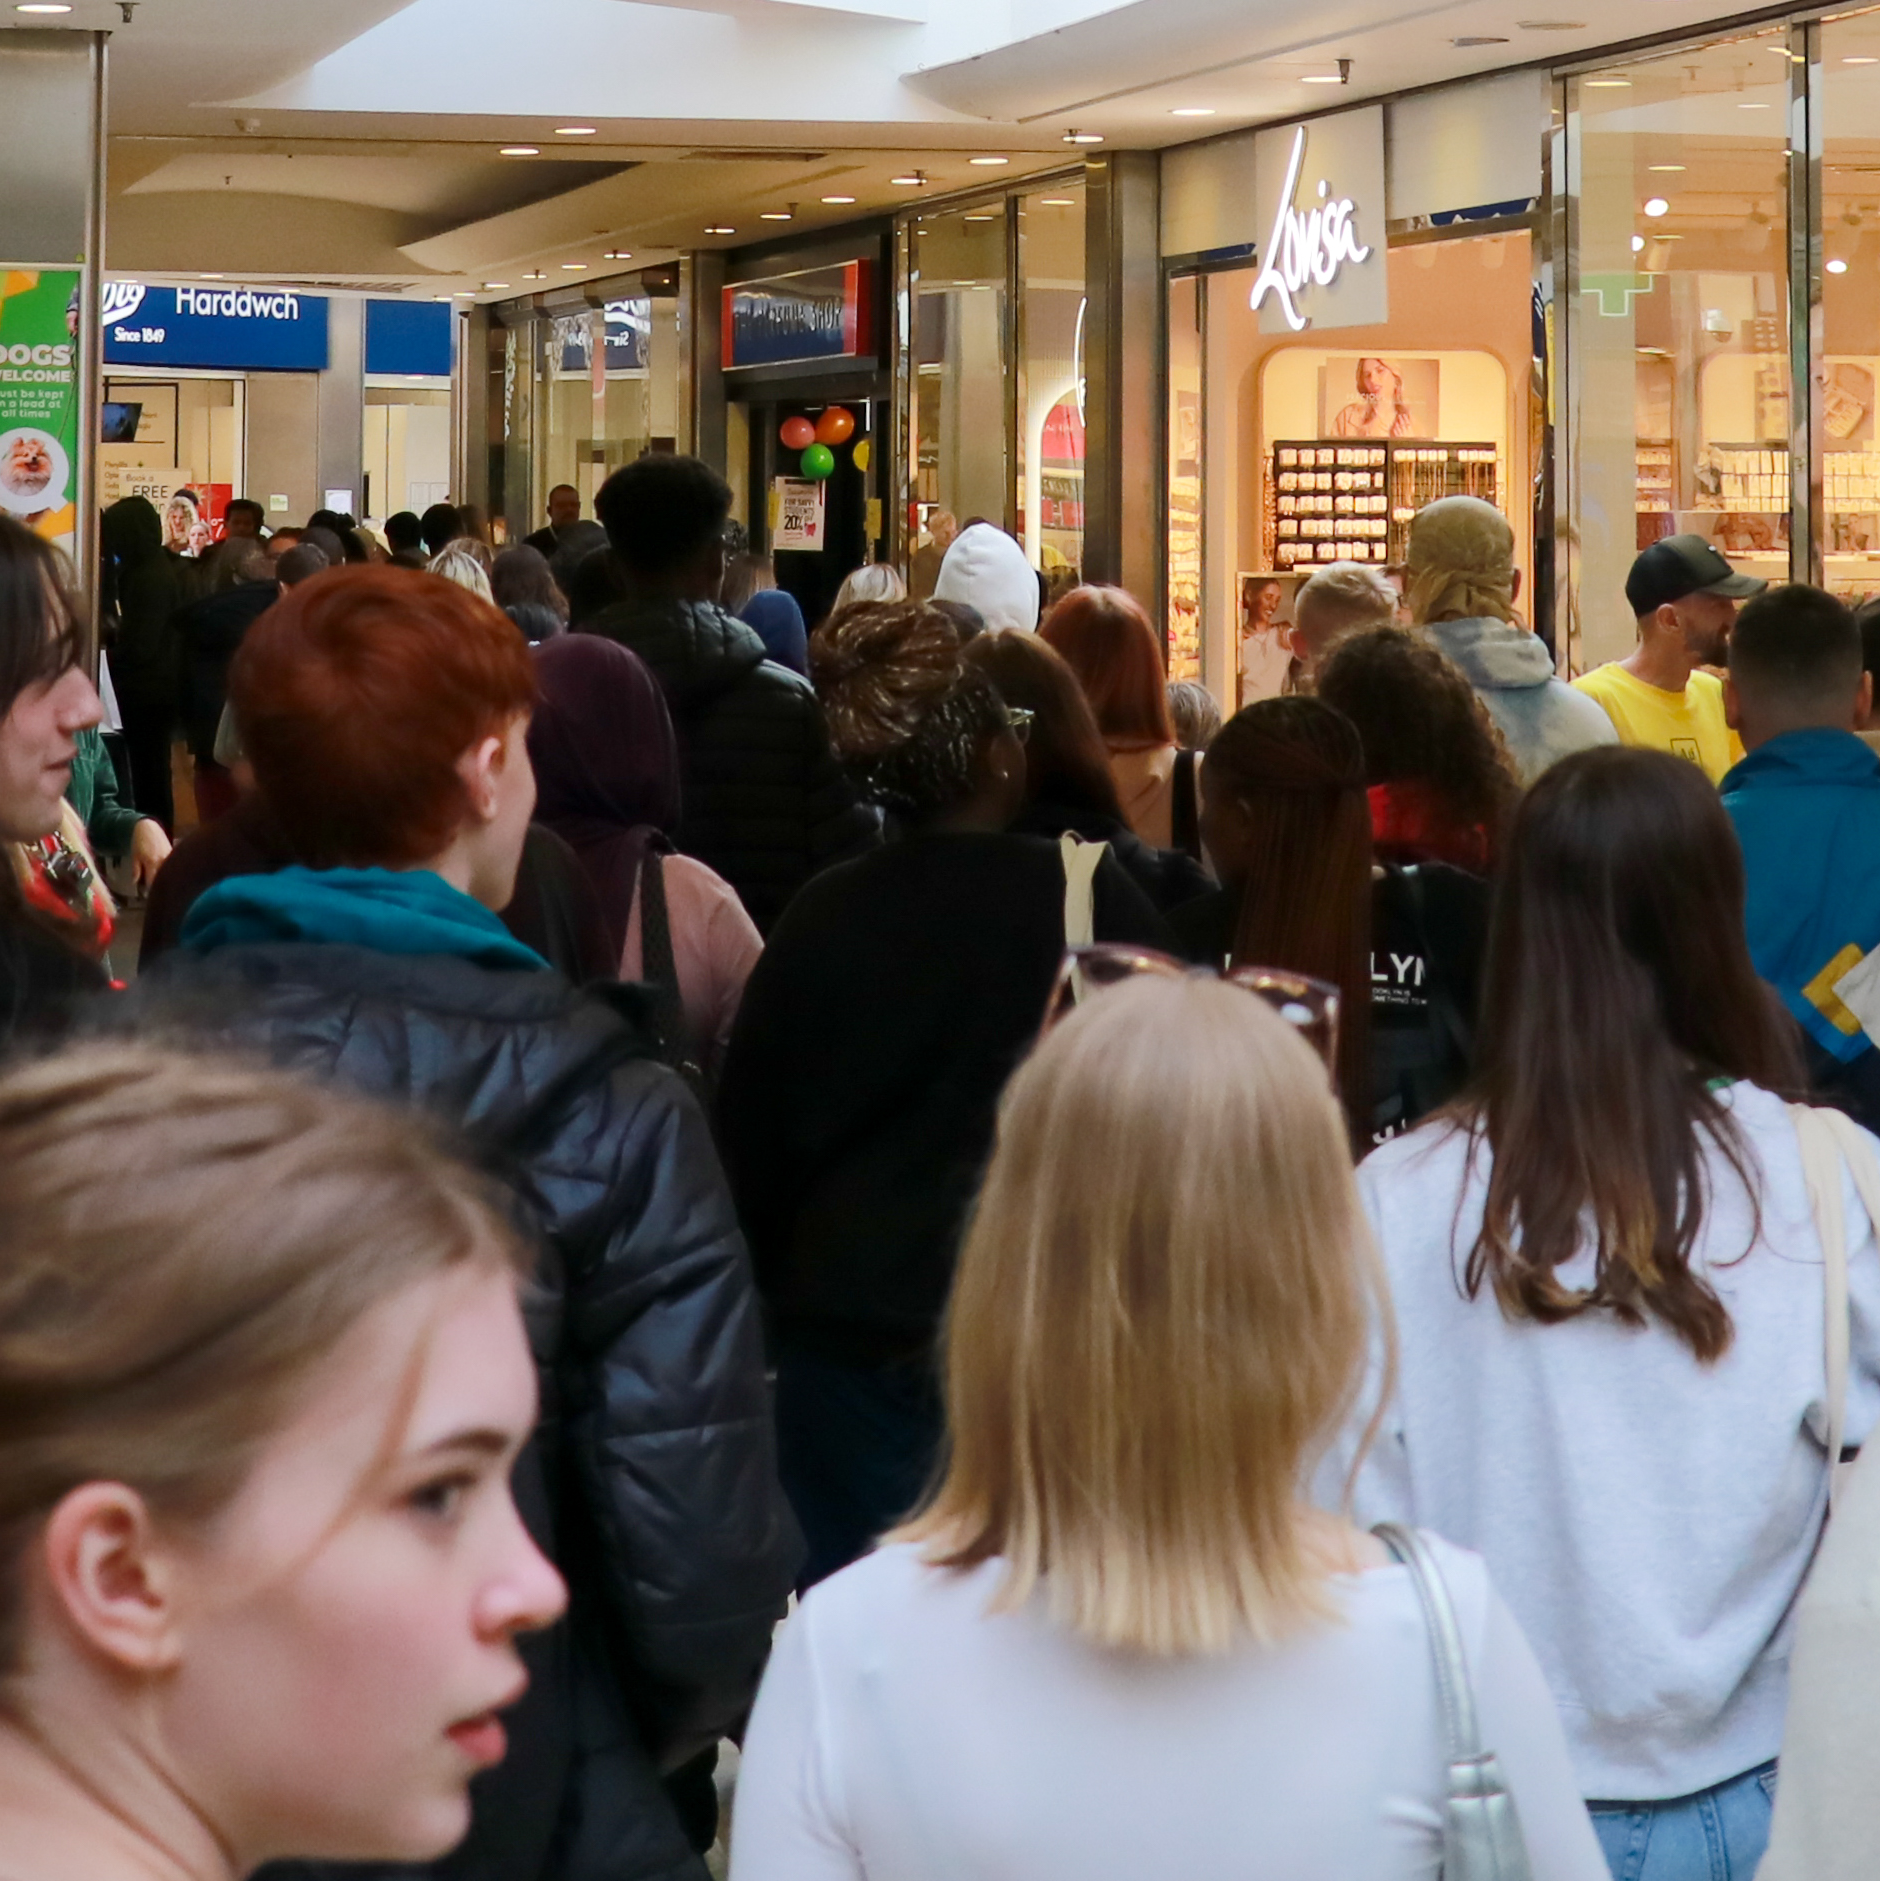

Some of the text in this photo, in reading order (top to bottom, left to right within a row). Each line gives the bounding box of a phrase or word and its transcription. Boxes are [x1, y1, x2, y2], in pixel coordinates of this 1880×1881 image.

[1250, 126, 1370, 331] Lovisa
[175, 287, 300, 320] Harddwch
[114, 326, 166, 344] Since 1849
[20, 389, 35, 399] be
[38, 389, 64, 401] kept
[19, 399, 45, 408] lead
[48, 400, 61, 408] at
[1, 409, 51, 418] all times
[132, 485, 169, 499] FREE
